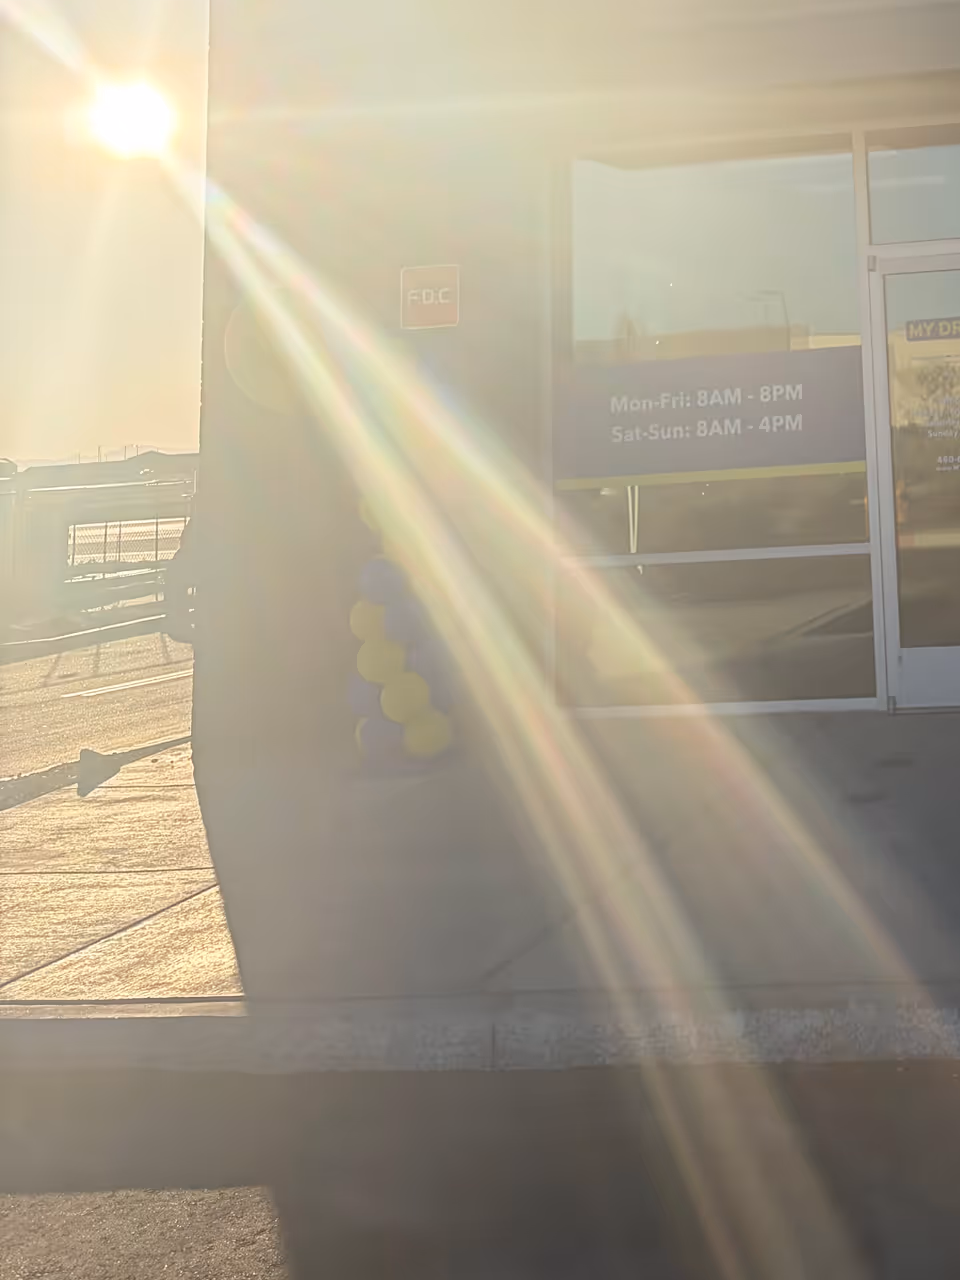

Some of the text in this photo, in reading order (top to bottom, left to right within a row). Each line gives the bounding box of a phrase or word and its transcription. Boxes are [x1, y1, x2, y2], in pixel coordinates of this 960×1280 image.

[908, 321, 934, 339] MY
[610, 391, 691, 414] Mon-Fri:
[696, 387, 742, 408] 8AM
[759, 383, 803, 403] 8PM
[611, 423, 691, 443] Sat-Sun:
[696, 418, 742, 437] 8AM
[758, 413, 803, 433] 4PM
